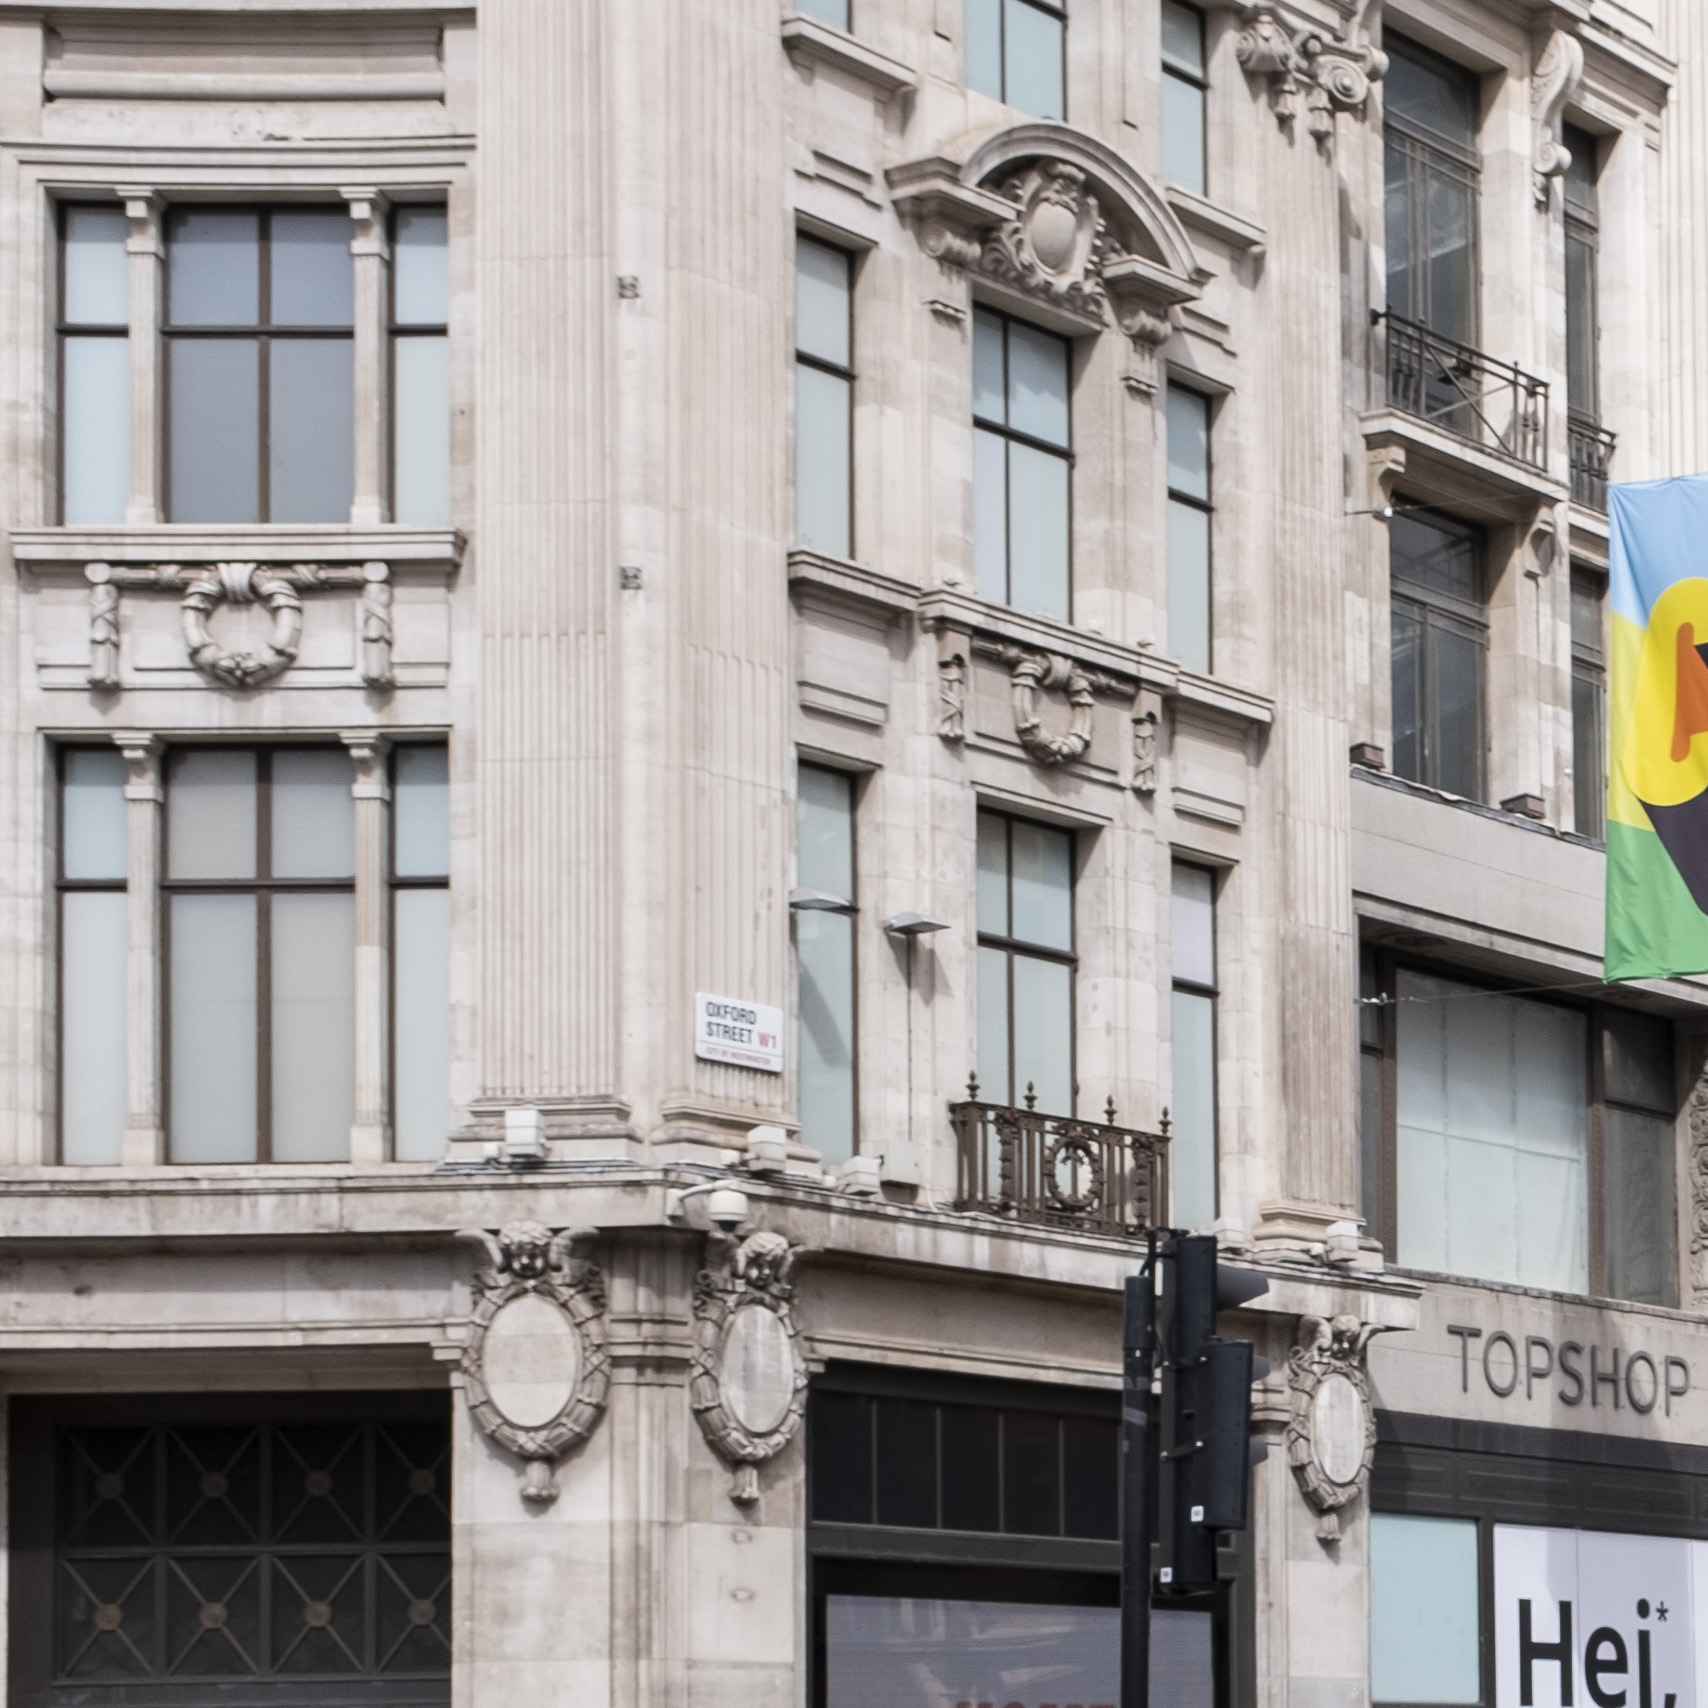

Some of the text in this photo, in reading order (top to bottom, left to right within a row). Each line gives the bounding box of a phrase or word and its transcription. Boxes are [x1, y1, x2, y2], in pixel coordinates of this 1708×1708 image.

[706, 1001, 757, 1025] OXFORD
[705, 1020, 777, 1049] STREET W1
[1447, 1323, 1691, 1417] TOPSHOP
